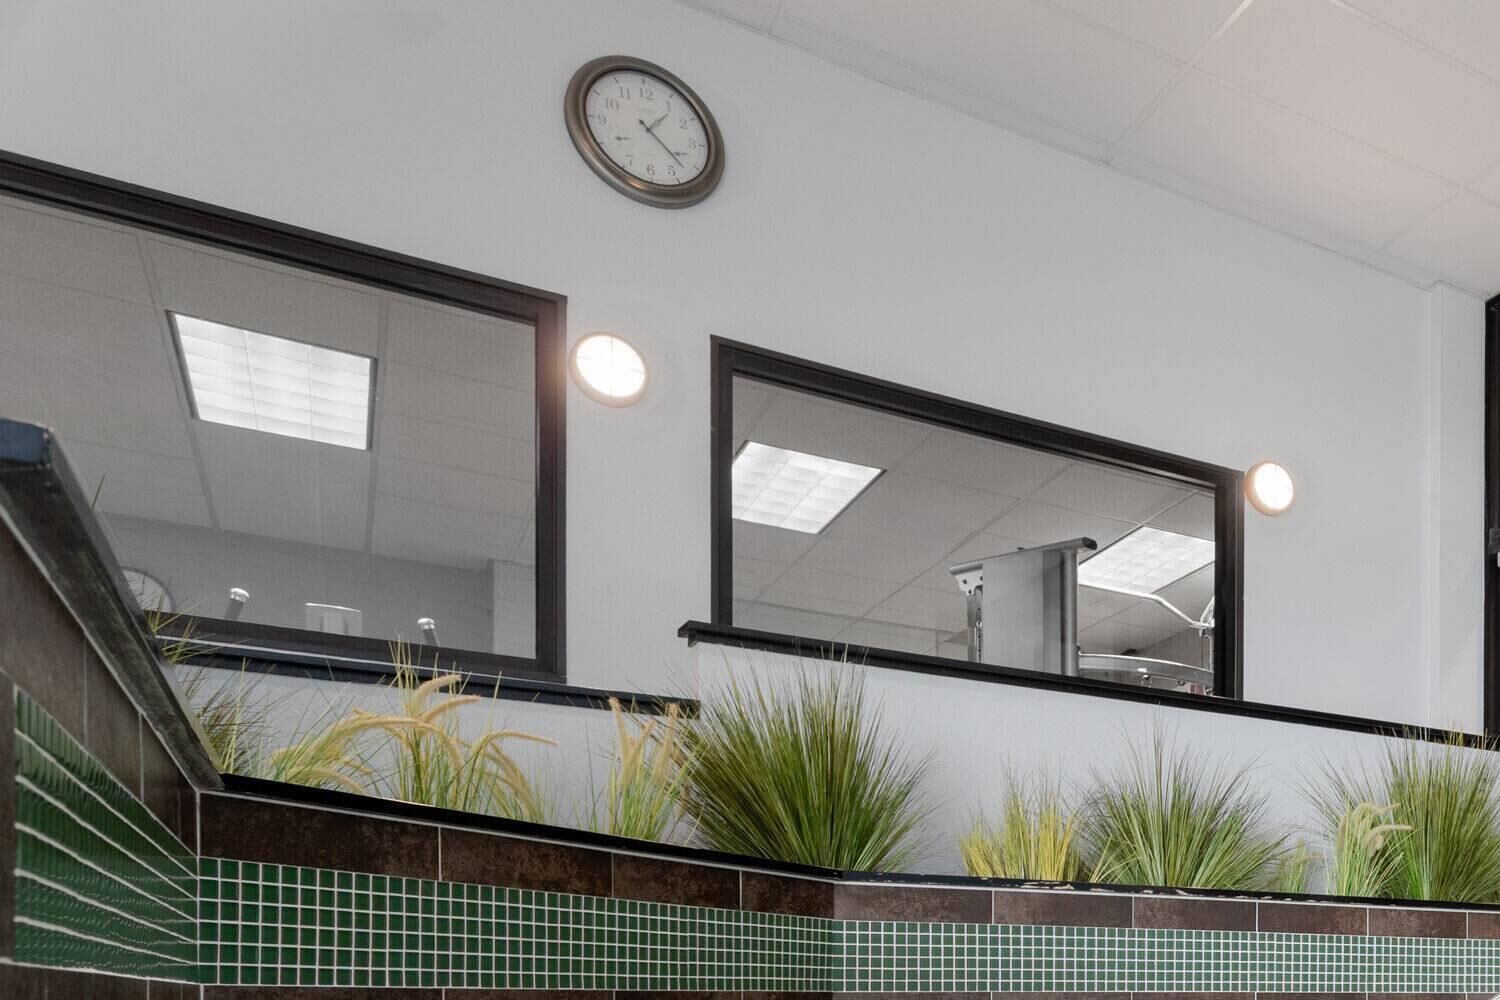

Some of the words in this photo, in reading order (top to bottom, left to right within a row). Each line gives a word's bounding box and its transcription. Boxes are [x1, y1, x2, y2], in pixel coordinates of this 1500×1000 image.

[619, 86, 631, 100] 11
[639, 87, 654, 101] 12
[605, 97, 619, 111] 10
[597, 114, 607, 127] 9
[679, 118, 688, 130] 2
[688, 138, 696, 150] 3
[625, 153, 634, 167] 7
[646, 163, 656, 176] 6
[667, 164, 676, 177] 5
